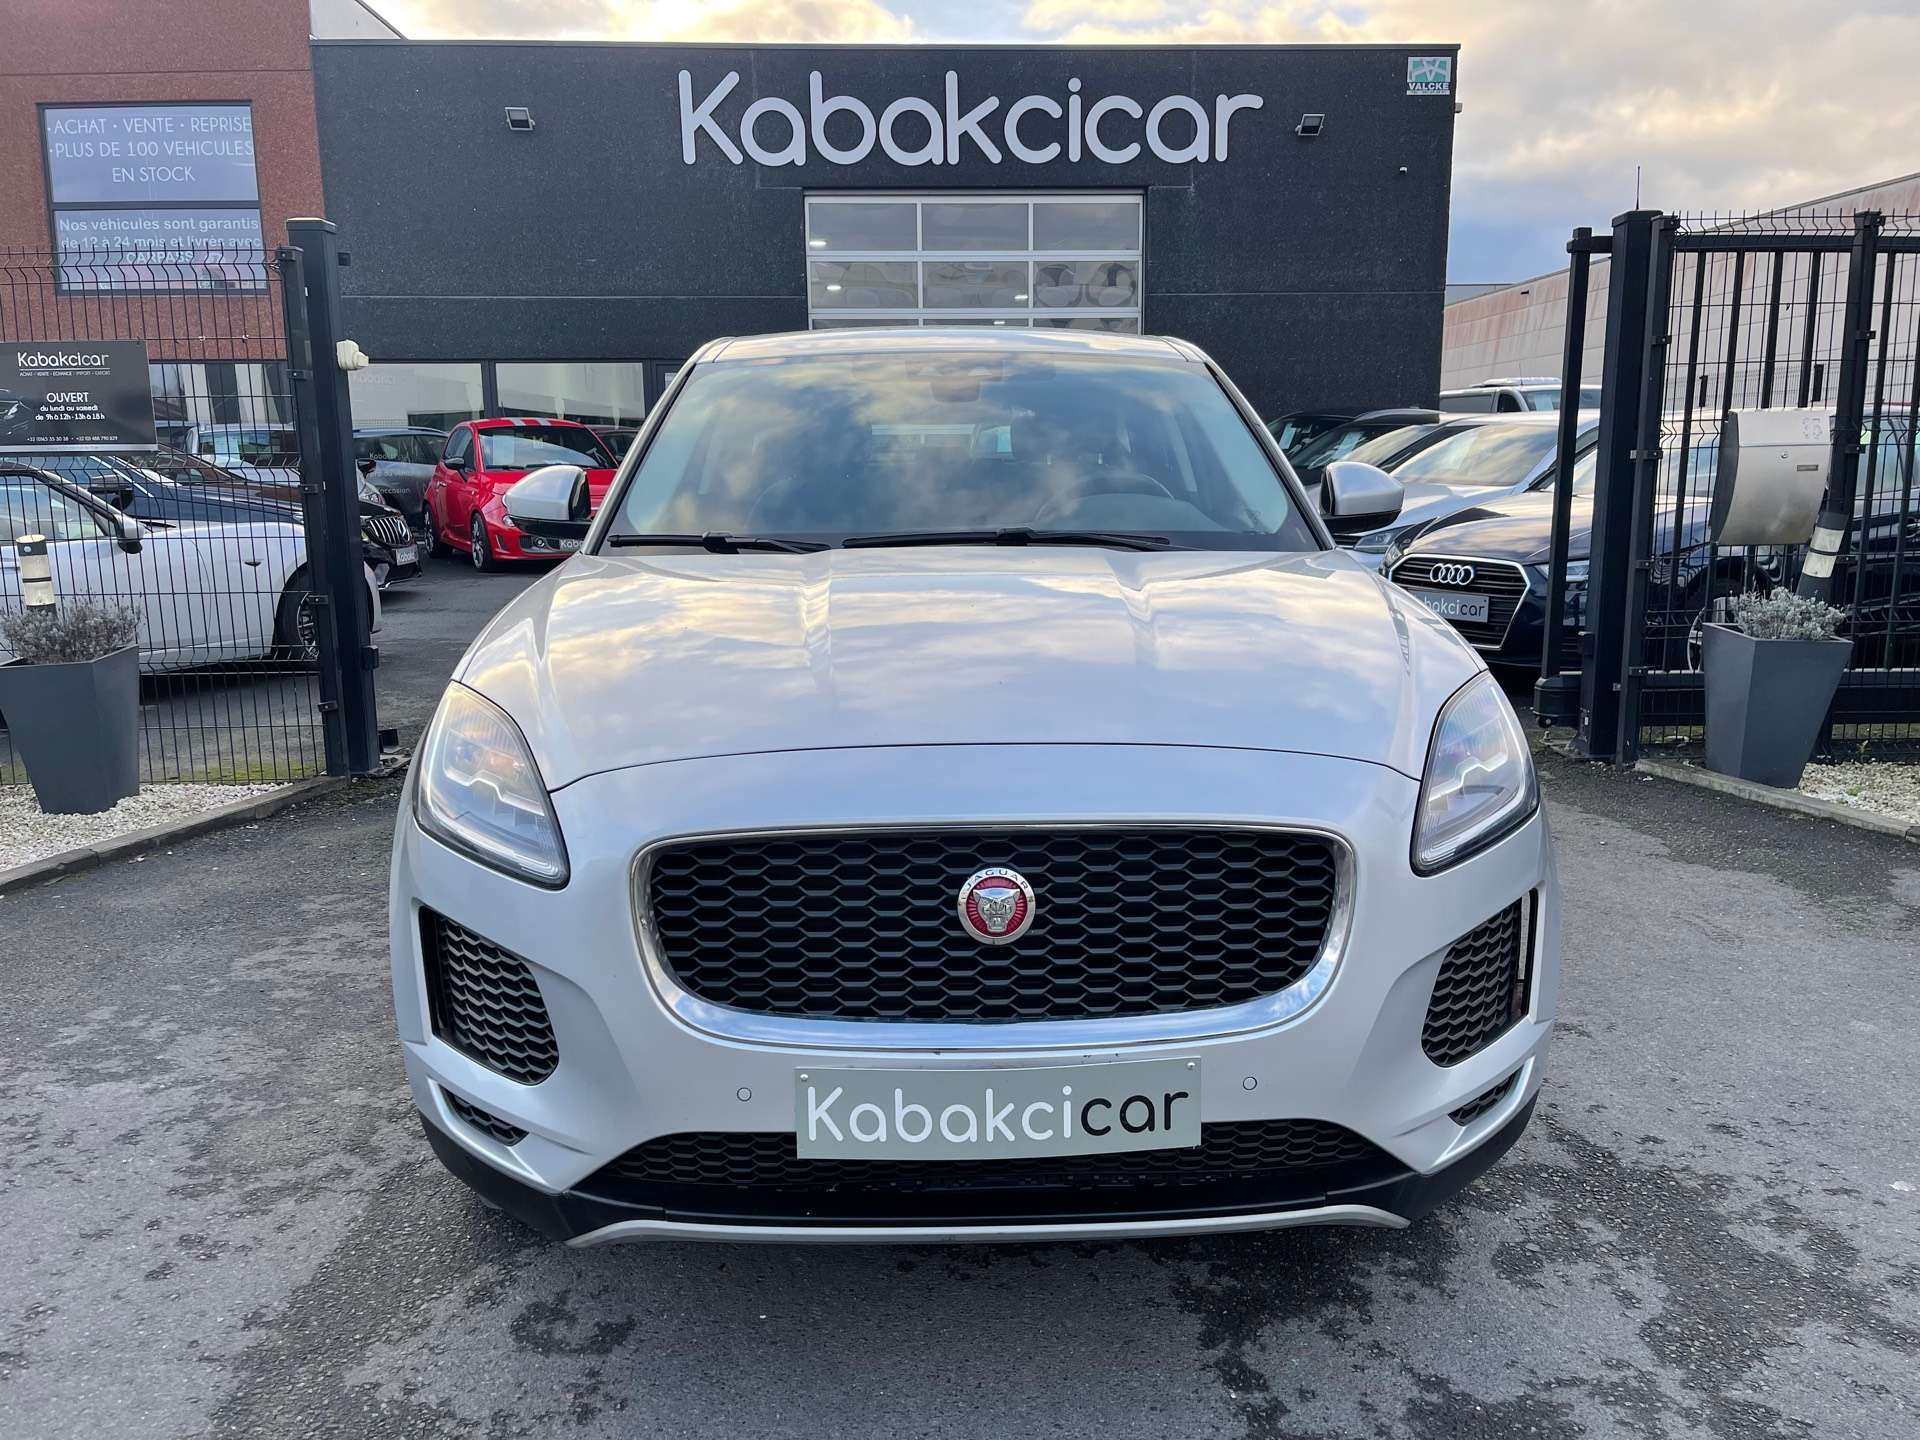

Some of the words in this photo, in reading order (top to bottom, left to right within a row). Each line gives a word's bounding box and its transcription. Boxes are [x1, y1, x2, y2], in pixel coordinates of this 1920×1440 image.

[1408, 82, 1449, 90] VALCKE
[54, 118, 106, 134] ACHAT
[122, 117, 174, 133] VENTE
[190, 116, 251, 132] REPRISE
[677, 69, 1264, 167] Kabakcicar
[55, 142, 95, 158] PLUS
[99, 142, 121, 157] DE
[128, 141, 158, 157] 100
[163, 140, 254, 156] VEHICULES
[112, 167, 135, 183] EN
[139, 166, 195, 182] STOCK
[59, 219, 88, 231] Nos
[91, 218, 160, 231] véhicules
[163, 218, 196, 231] sont
[199, 217, 259, 233] garantis
[61, 237, 79, 249] de
[83, 236, 98, 248] 12
[114, 236, 130, 247] 24
[134, 235, 166, 247] mois
[170, 236, 185, 247] et
[228, 238, 261, 247] avec
[126, 250, 194, 264] CARPASS
[17, 351, 110, 367] Kabakcicar
[46, 392, 89, 403] OUVERT
[965, 868, 1029, 892] JAGUAR
[807, 1085, 1189, 1143] Kabakcicar
